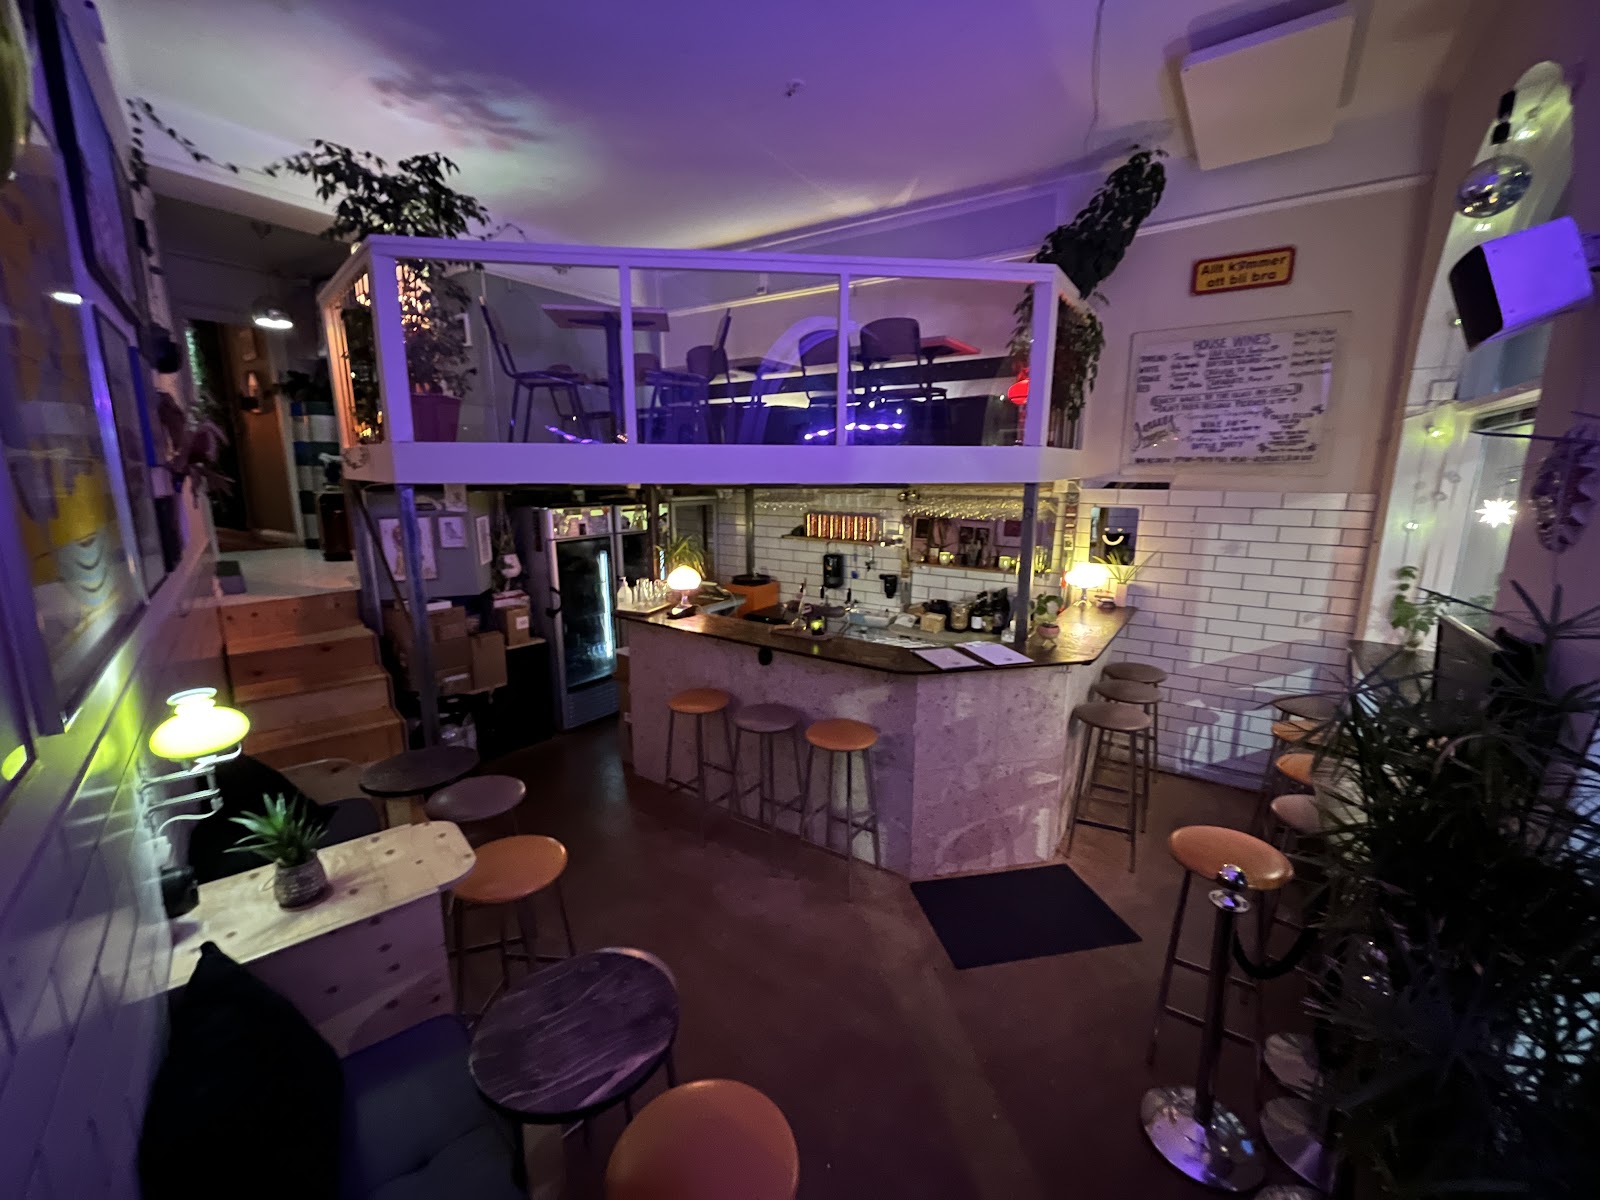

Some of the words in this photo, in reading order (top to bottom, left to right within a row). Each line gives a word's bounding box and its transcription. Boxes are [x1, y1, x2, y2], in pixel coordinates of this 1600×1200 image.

[1201, 263, 1224, 275] Allt
[1207, 277, 1225, 287] att
[1229, 273, 1248, 284] bli
[1252, 271, 1277, 281] bra
[1193, 337, 1227, 350] HOUSE
[1232, 333, 1271, 347] WINES
